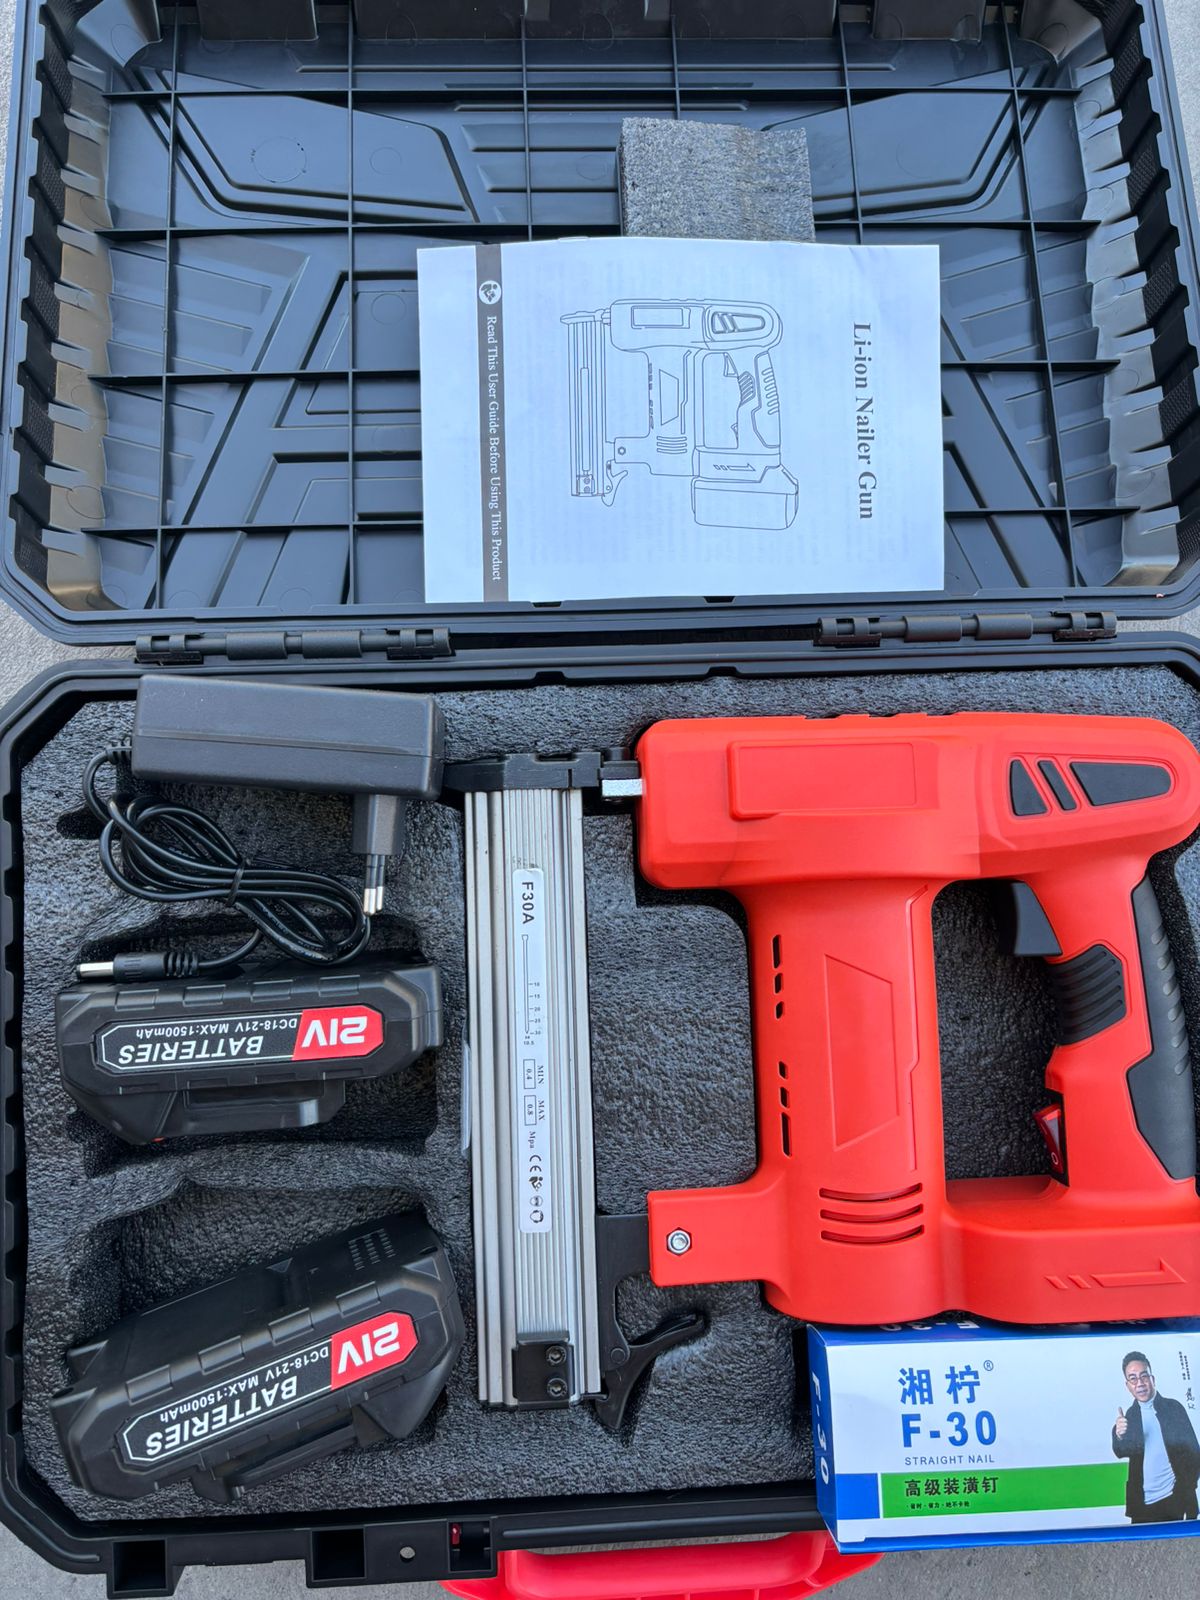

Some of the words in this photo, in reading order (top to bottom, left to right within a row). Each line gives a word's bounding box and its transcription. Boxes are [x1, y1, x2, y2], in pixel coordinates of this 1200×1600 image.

[485, 315, 498, 344] Read
[486, 345, 499, 371] This
[853, 322, 873, 389] Li-ion
[487, 372, 499, 399] User
[488, 401, 501, 434] Guide
[855, 396, 876, 465] Nailer
[488, 436, 501, 474] Before
[487, 476, 502, 509] Using
[857, 471, 877, 520] Gun
[490, 511, 503, 537] This
[490, 538, 503, 581] Product
[521, 881, 535, 925] F30A
[135, 1022, 230, 1040] MAX:1500mAh
[234, 1017, 298, 1033] DC18-21V
[117, 1035, 264, 1065] BATTERIES
[537, 1064, 545, 1085] MIN
[538, 1099, 546, 1121] MAX
[529, 1131, 537, 1149] Mpa
[263, 1345, 330, 1383] DC18-21V
[145, 1374, 298, 1457] BATTERIES
[159, 1374, 260, 1424] MAX:1500mAh
[811, 1372, 829, 1485] F-30
[901, 1410, 997, 1448] F-30
[904, 1455, 965, 1466] STRAIGHT
[968, 1454, 995, 1464] NAIL
[904, 1476, 999, 1497] 高级装潢钉
